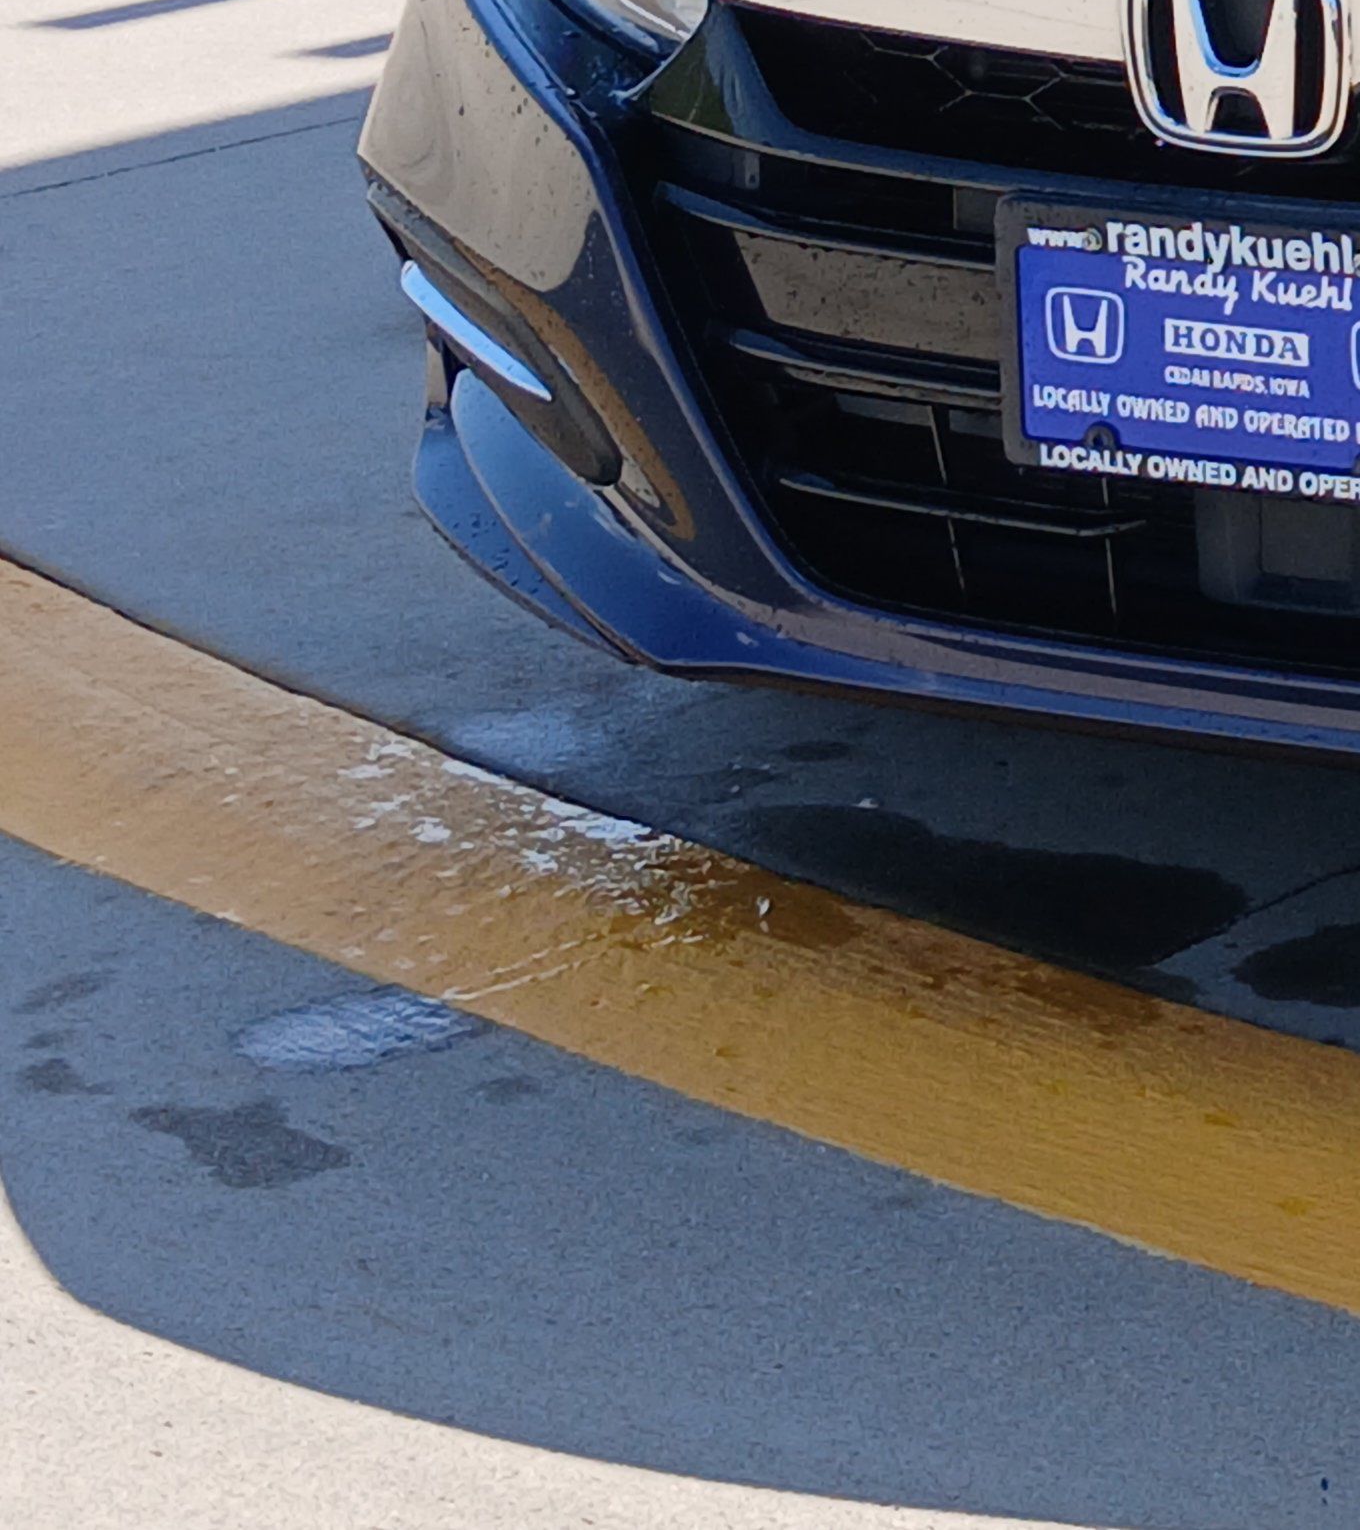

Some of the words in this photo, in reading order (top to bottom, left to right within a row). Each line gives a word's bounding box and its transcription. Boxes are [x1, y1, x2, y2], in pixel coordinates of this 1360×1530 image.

[1122, 255, 1239, 315] Randy
[1251, 270, 1353, 311] Kuehl
[1171, 324, 1302, 361] HONDA
[1033, 384, 1110, 416] LOCALLY
[1116, 394, 1190, 423] OWNED
[1195, 404, 1238, 430] AND
[1243, 409, 1350, 442] OPERATED
[1040, 443, 1142, 476] LOCALLY
[1147, 455, 1237, 486] OWNED
[1240, 465, 1295, 492] AND
